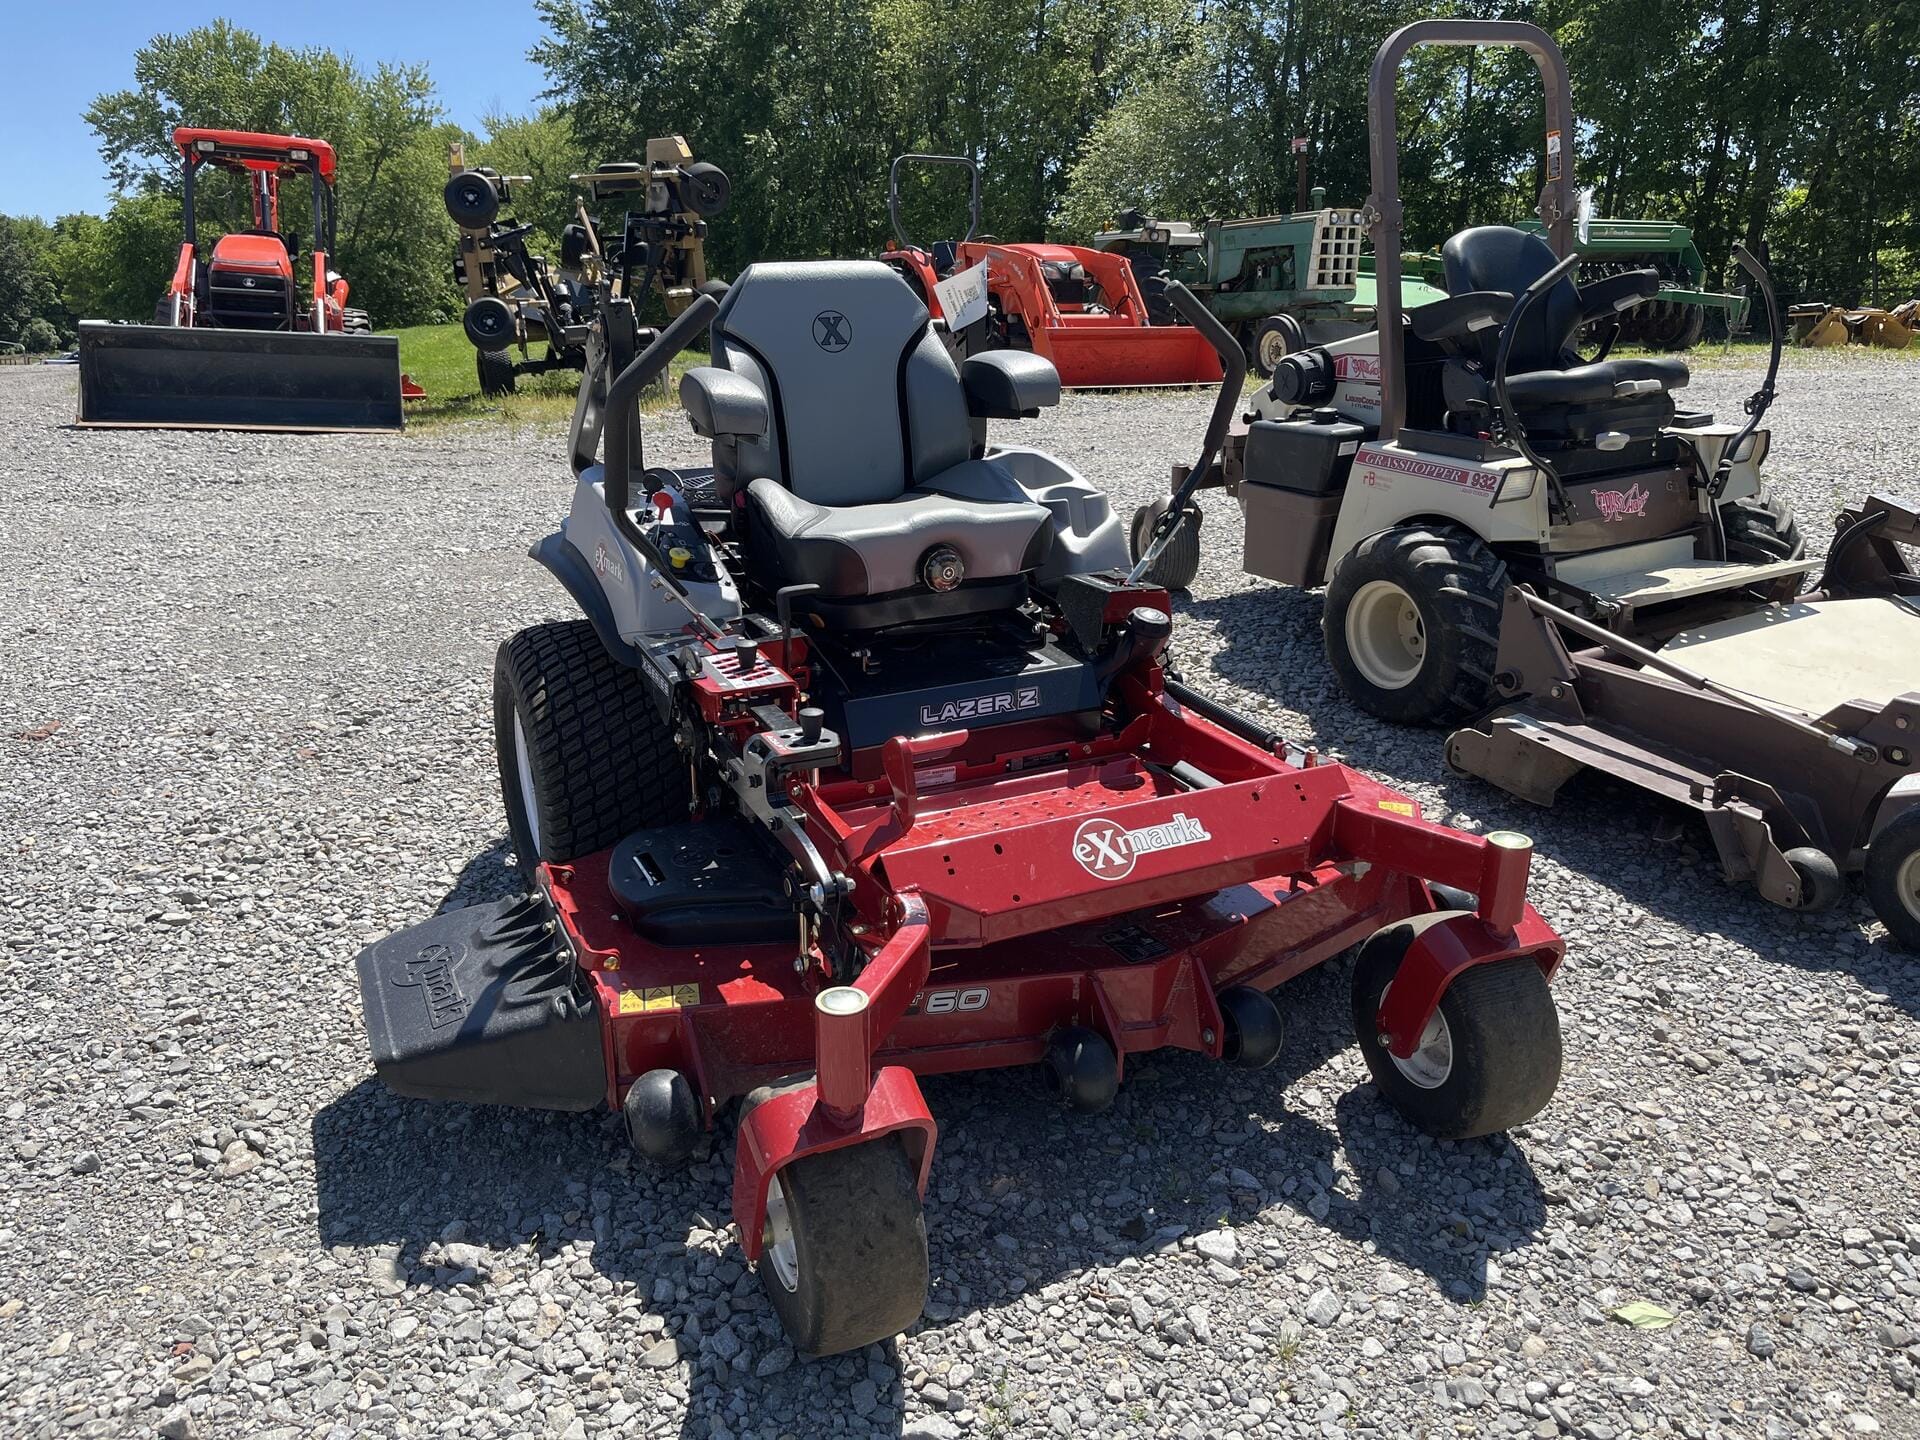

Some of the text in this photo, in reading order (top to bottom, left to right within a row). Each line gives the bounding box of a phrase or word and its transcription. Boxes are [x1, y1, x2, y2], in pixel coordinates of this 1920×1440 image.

[1365, 453, 1497, 490] GRASSHOPPER 932
[920, 686, 1040, 726] LAZER Z
[1073, 812, 1212, 870] eXmark
[925, 987, 991, 1015] 60
